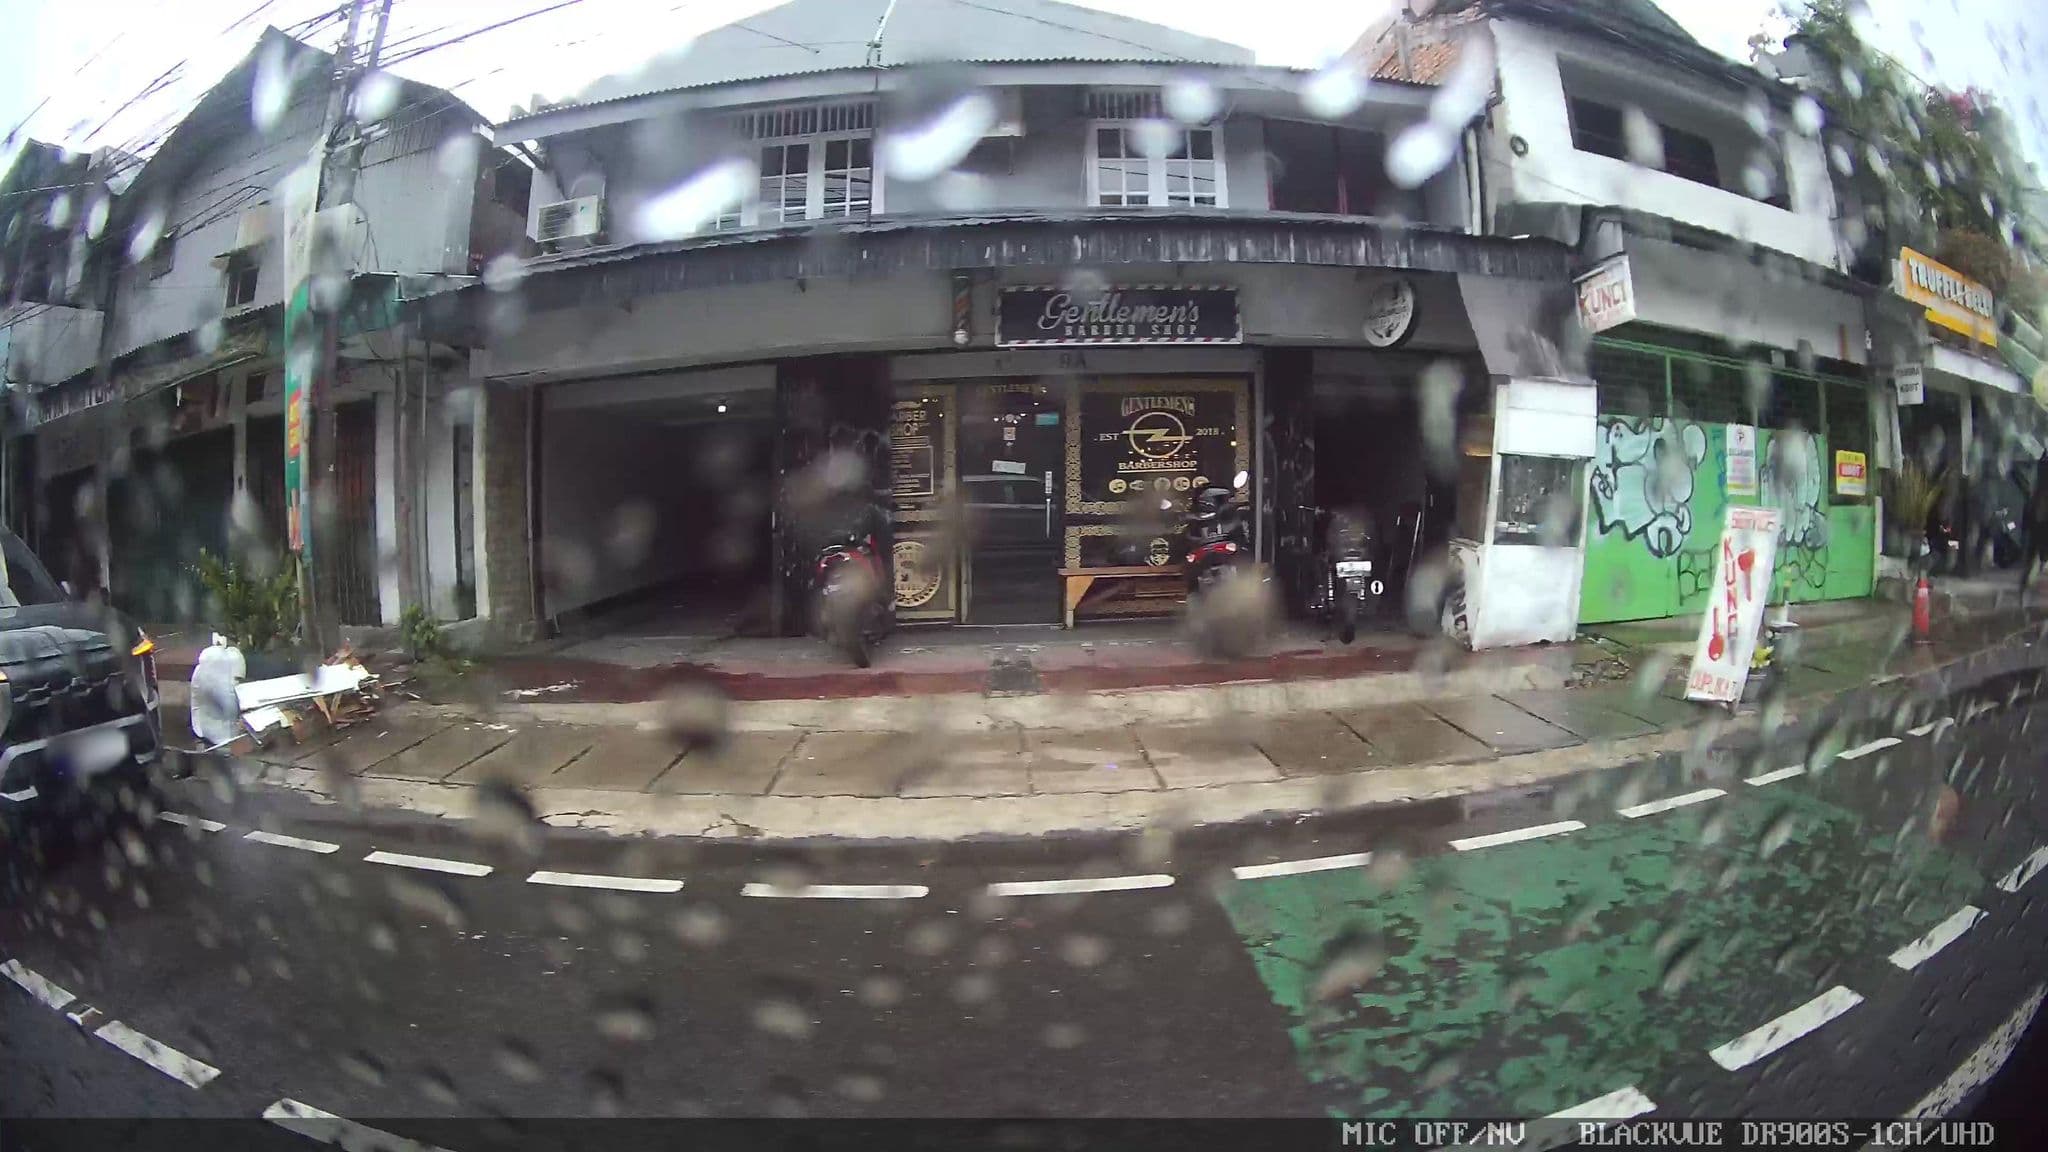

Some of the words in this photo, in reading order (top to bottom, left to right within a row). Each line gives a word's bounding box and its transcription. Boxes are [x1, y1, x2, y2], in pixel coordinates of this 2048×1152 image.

[1037, 293, 1200, 330] Gentlemen's
[1064, 325, 1136, 336] BARBER
[1152, 324, 1198, 335] SHOP
[1118, 460, 1198, 470] BARBERSHOP
